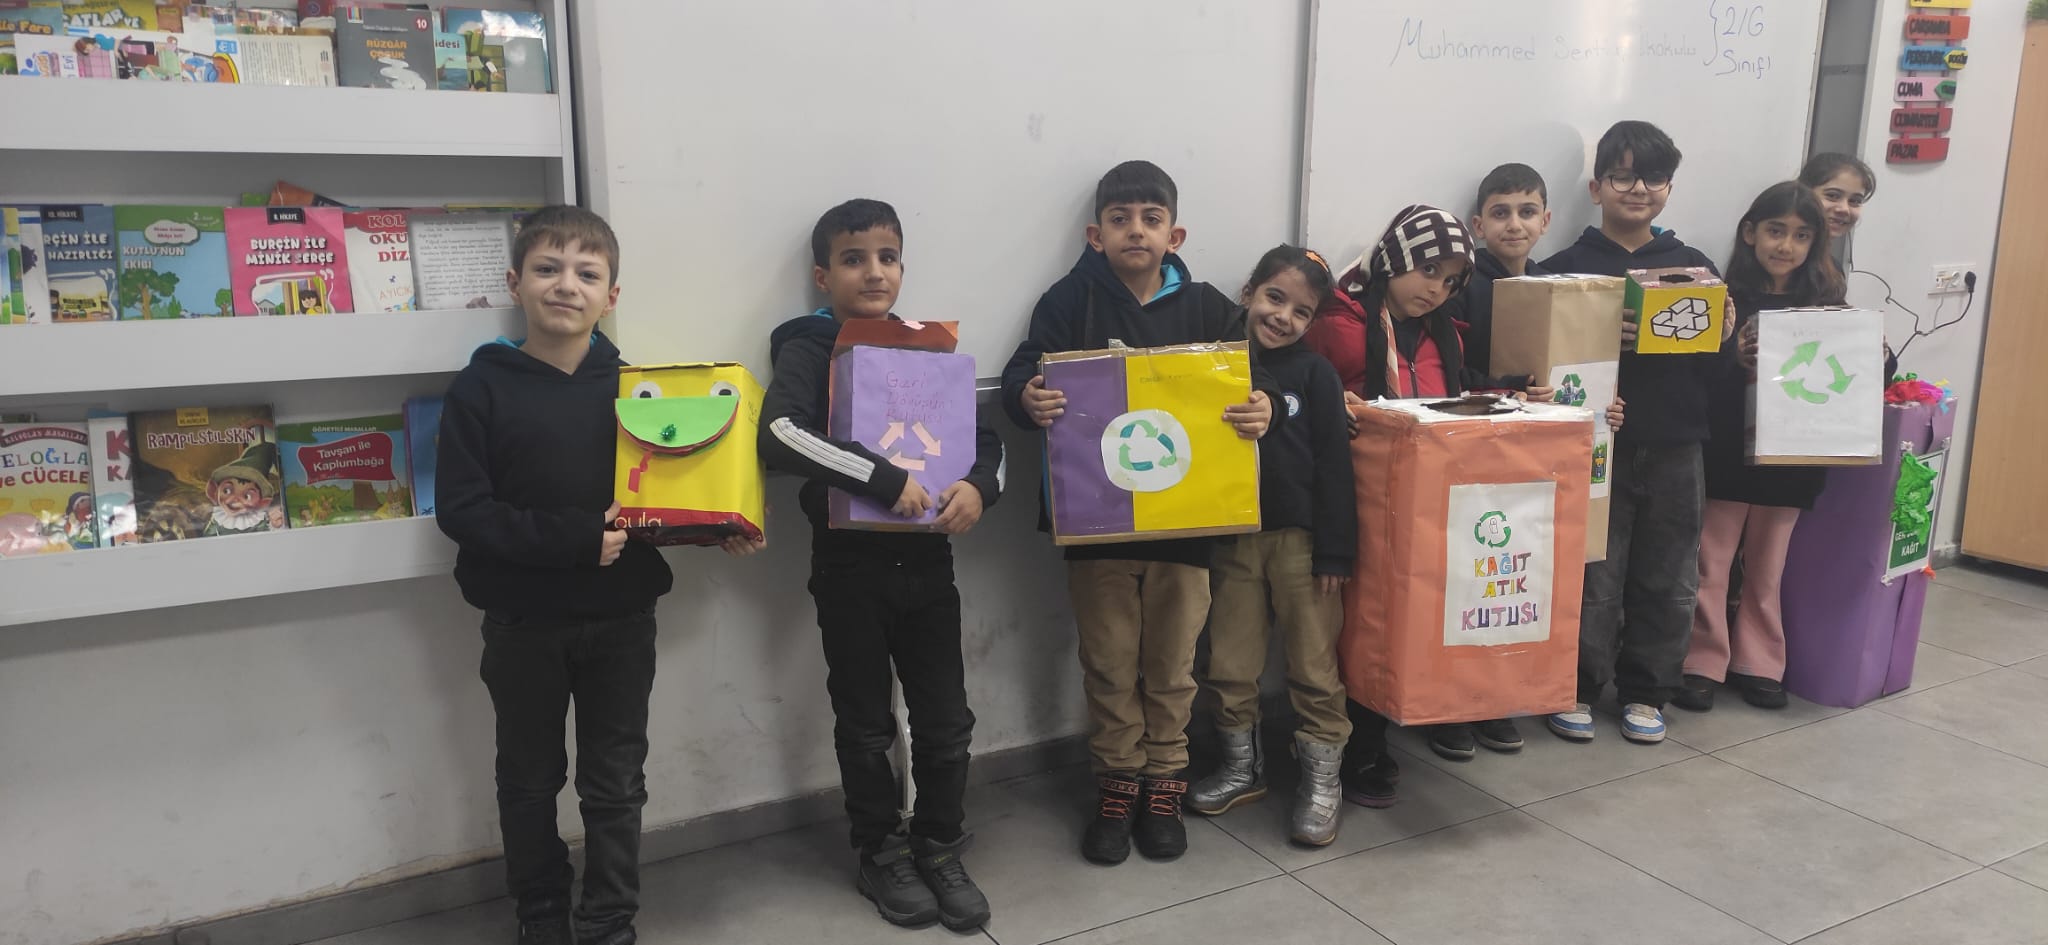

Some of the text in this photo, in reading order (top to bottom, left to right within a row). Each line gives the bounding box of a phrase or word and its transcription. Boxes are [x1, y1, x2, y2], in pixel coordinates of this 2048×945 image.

[416, 18, 427, 28] 10
[1390, 18, 1536, 66] Muhammed
[1897, 82, 1923, 97] CUMA
[83, 230, 108, 244] İLE
[250, 235, 327, 251] BURÇİN İLE
[48, 248, 113, 261] HAZIRLIĞI
[245, 251, 335, 266] MİNİK SERÇE
[318, 440, 372, 460] Tavşan ile
[313, 456, 385, 473] Kaplumbağa
[21, 466, 89, 485] CÜCELE
[1901, 542, 1919, 557] KAĞIT
[1474, 552, 1532, 578] KAĞIT
[1481, 575, 1528, 599] ATIK
